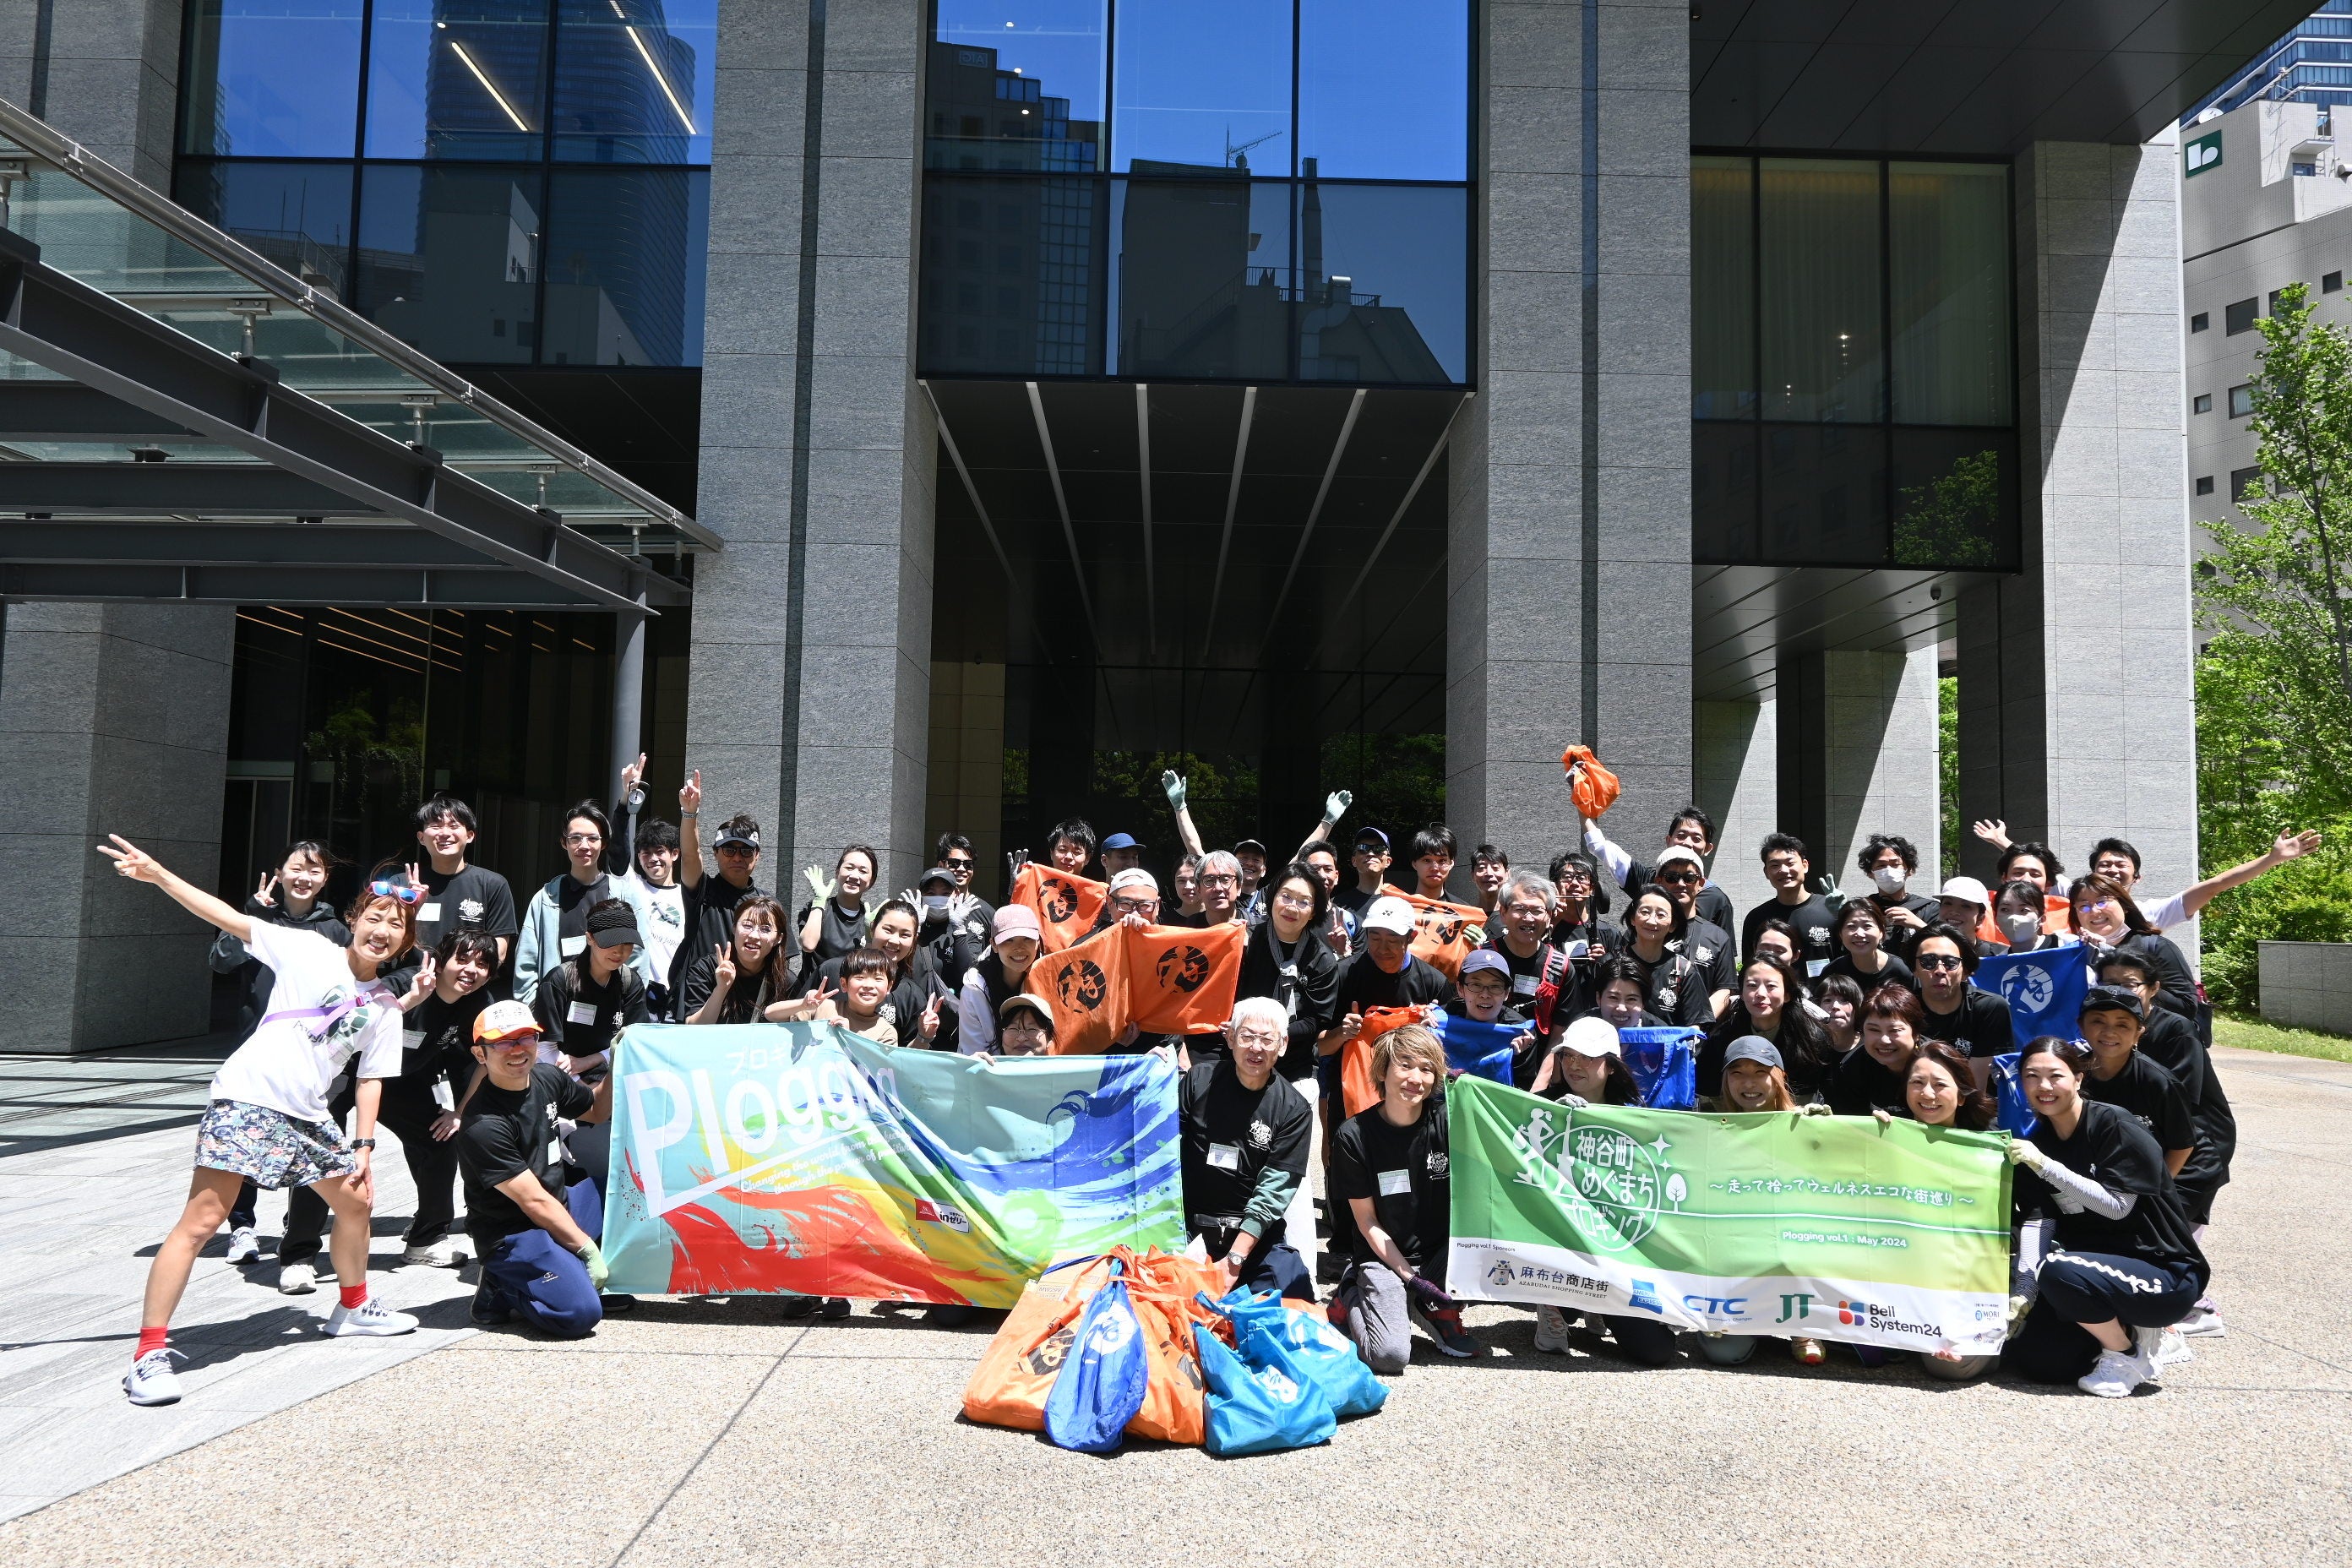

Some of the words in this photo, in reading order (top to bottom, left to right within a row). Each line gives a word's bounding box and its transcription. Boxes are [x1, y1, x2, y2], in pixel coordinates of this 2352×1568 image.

[1576, 1130, 1636, 1171] 神谷町
[741, 1168, 792, 1192] Changing
[792, 1161, 810, 1173] the
[817, 1166, 835, 1179] the
[1582, 1167, 1654, 1211] めぐまち
[1560, 1199, 1646, 1243] プロギング
[1782, 1231, 1825, 1243] Plogging
[1827, 1234, 1848, 1243] vol.1
[1857, 1235, 1878, 1247] May
[1881, 1237, 1907, 1248] 2024
[1519, 1281, 1550, 1289] AZABUDAI
[1551, 1285, 1583, 1295] SHOPPING
[1520, 1266, 1609, 1293] 麻布台商店街
[1682, 1294, 1749, 1315] CTC
[1775, 1293, 1816, 1324] JT
[1870, 1304, 1895, 1318] Bell
[1870, 1316, 1942, 1338] System24
